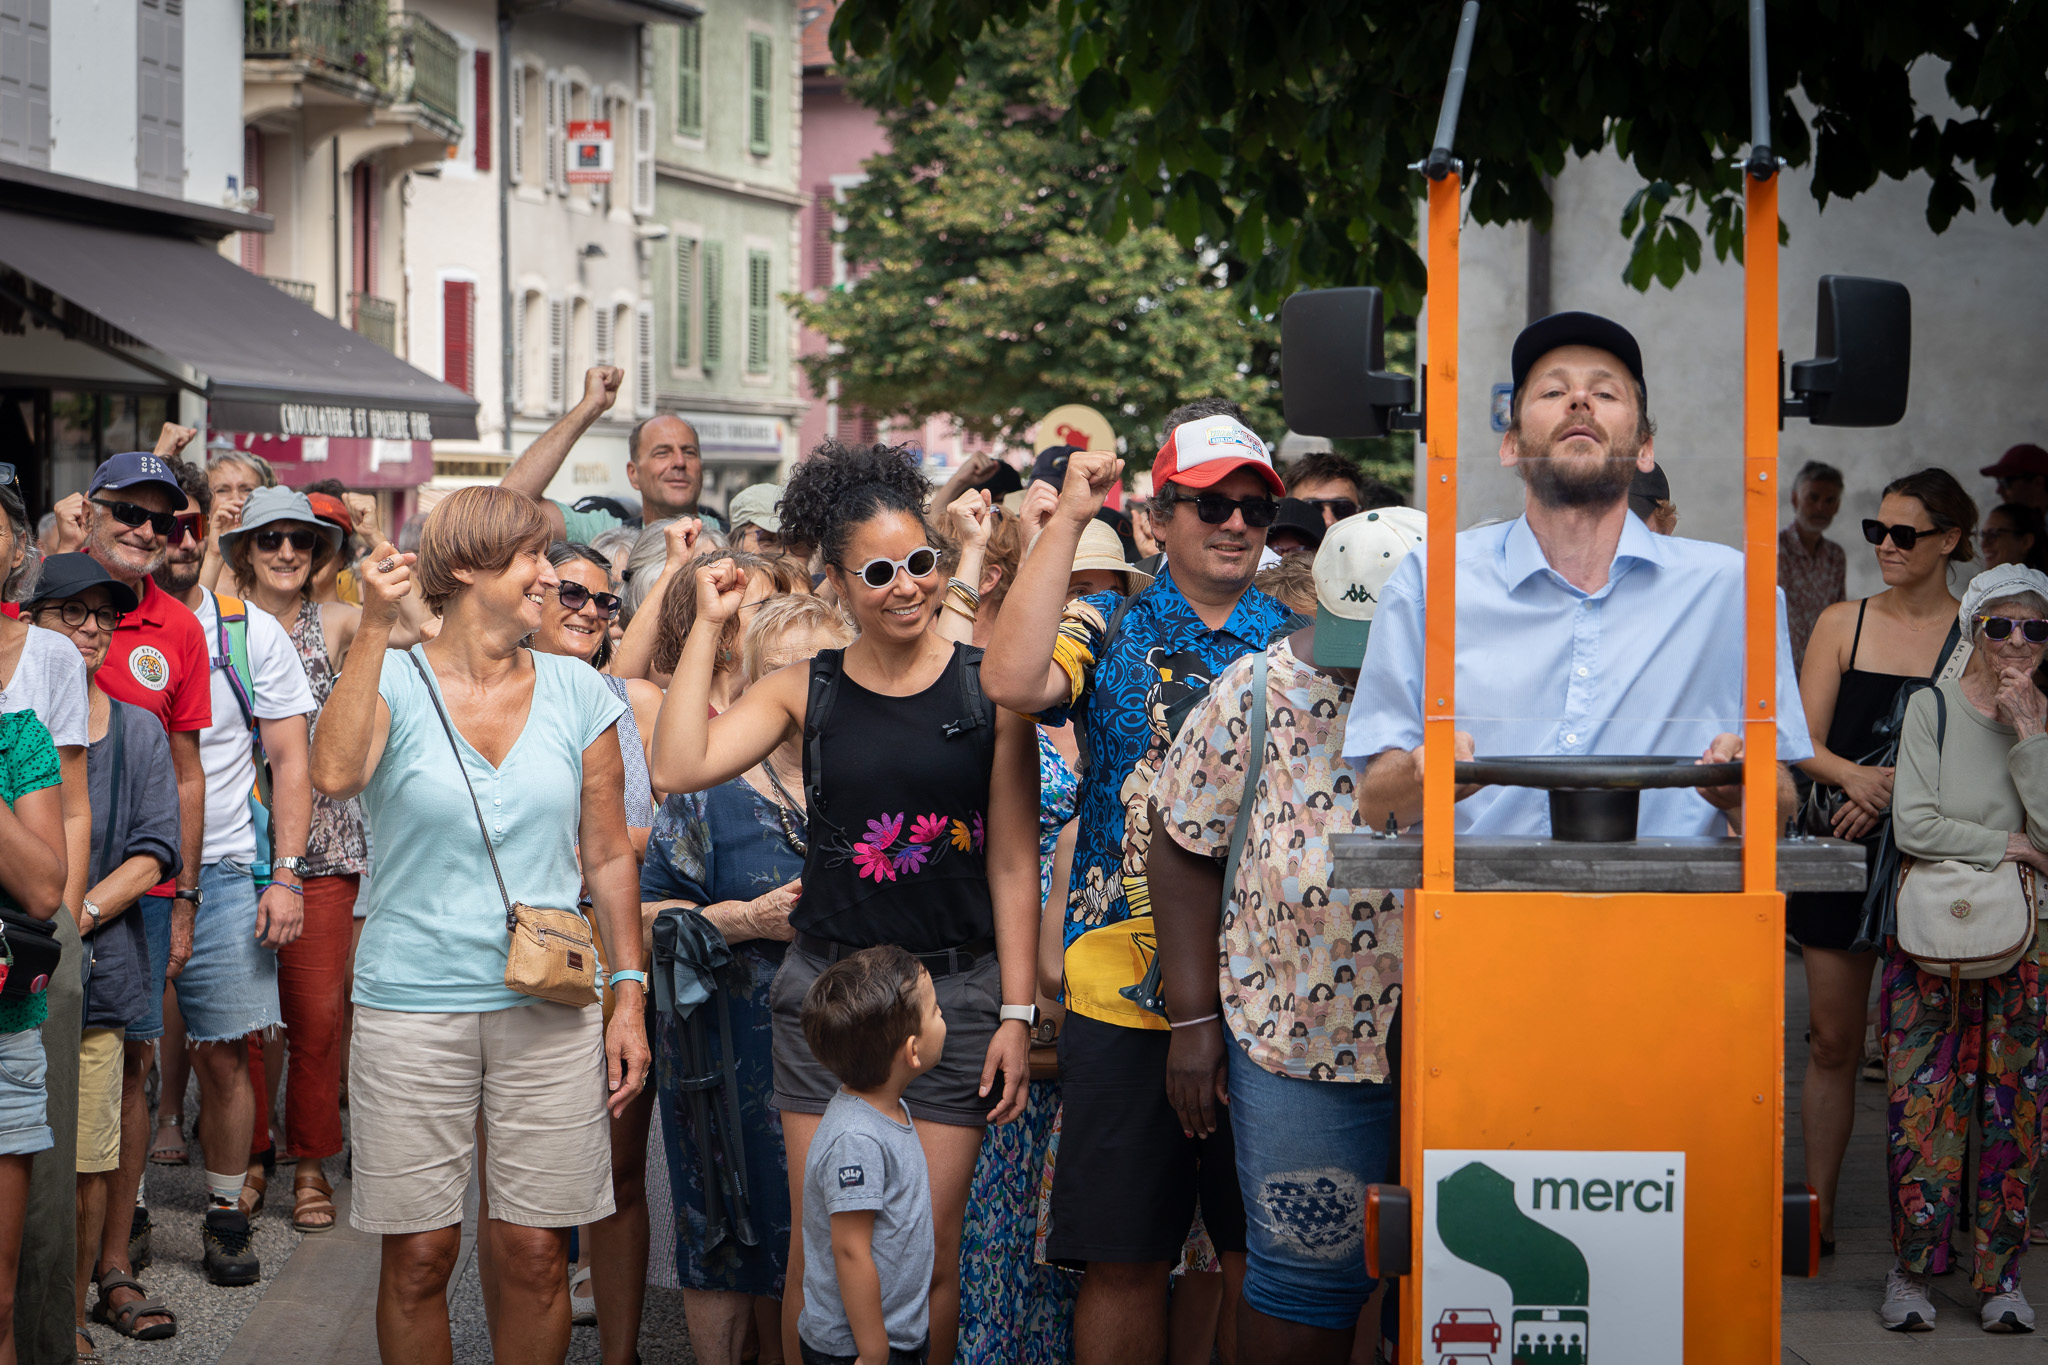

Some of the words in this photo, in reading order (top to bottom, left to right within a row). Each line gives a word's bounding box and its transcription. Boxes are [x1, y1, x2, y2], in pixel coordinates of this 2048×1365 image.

[280, 403, 354, 437] CHOCOLATERIE
[354, 408, 367, 438] ET
[410, 411, 433, 441] FINE
[141, 648, 162, 660] ETYEK
[839, 1168, 862, 1182] LULU
[1532, 1168, 1675, 1213] merci
